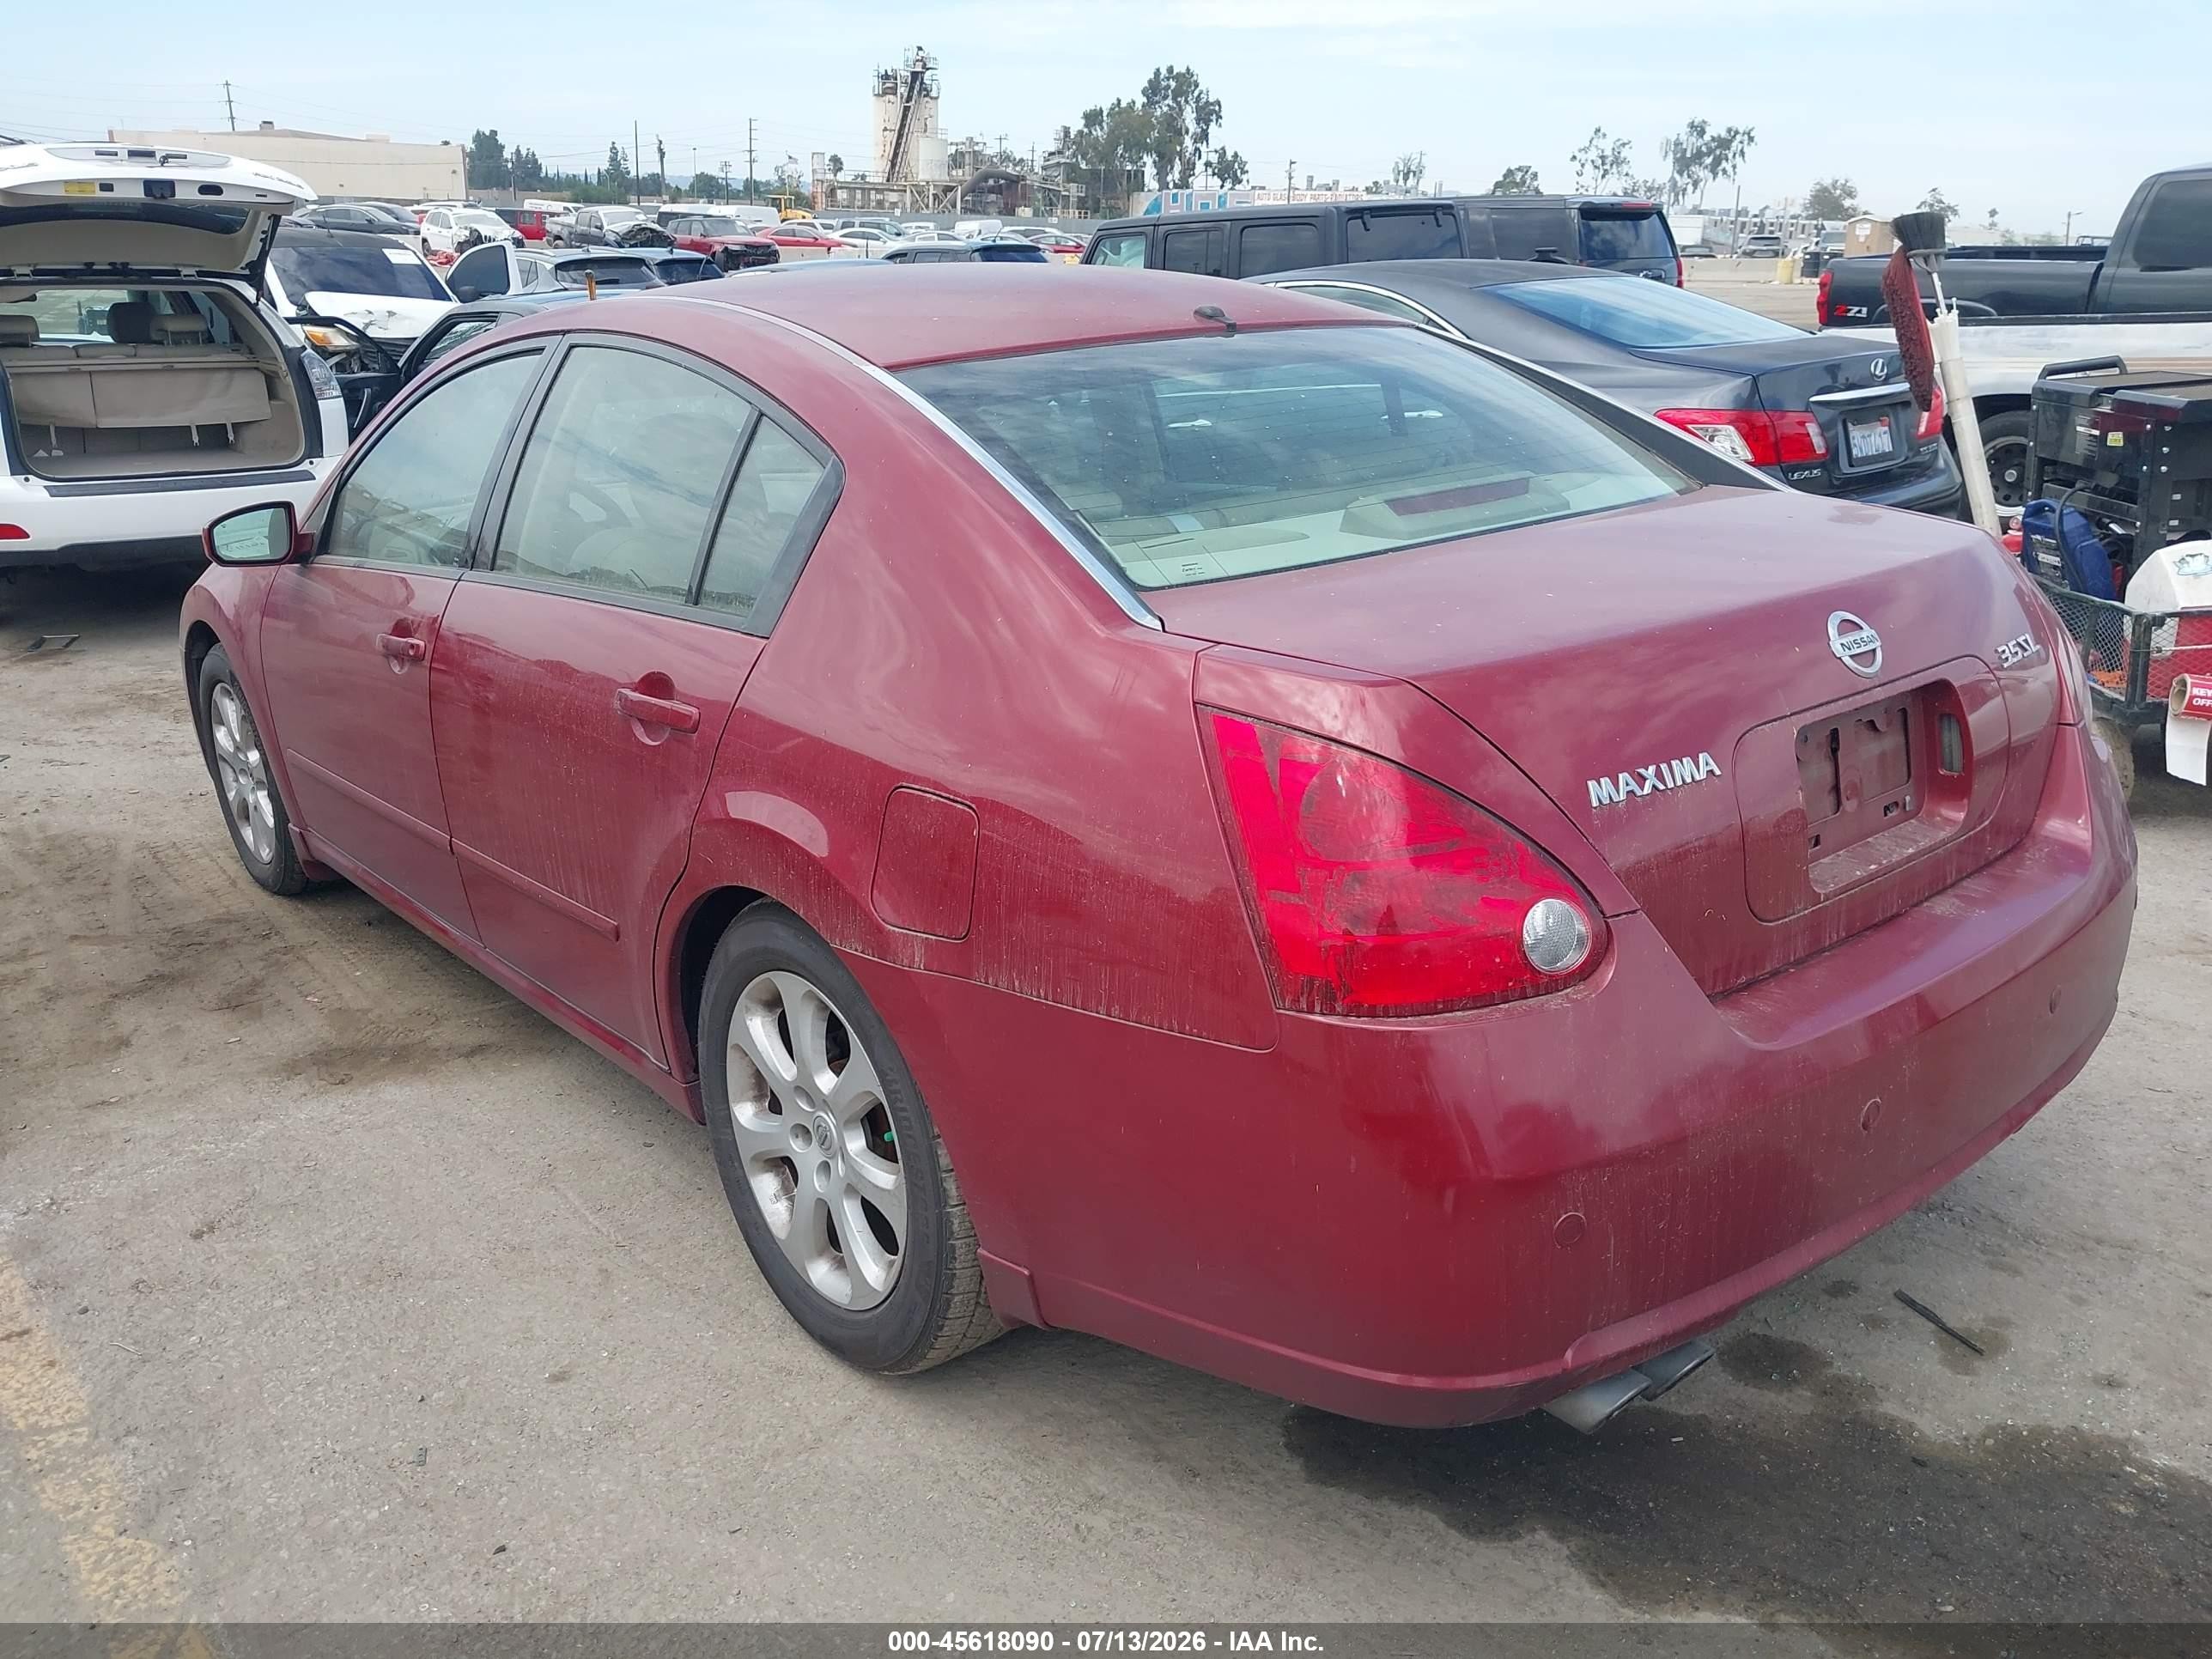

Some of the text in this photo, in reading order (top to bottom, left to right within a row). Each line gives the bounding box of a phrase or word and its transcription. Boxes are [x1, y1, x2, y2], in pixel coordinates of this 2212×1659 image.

[1256, 192, 1272, 202] AUTO
[1272, 191, 1289, 202] GLAS
[1834, 304, 1869, 318] Z71
[1788, 468, 1821, 481] LEXUS
[1839, 634, 1879, 653] NISSAN
[1586, 751, 1723, 808] MAXIMA
